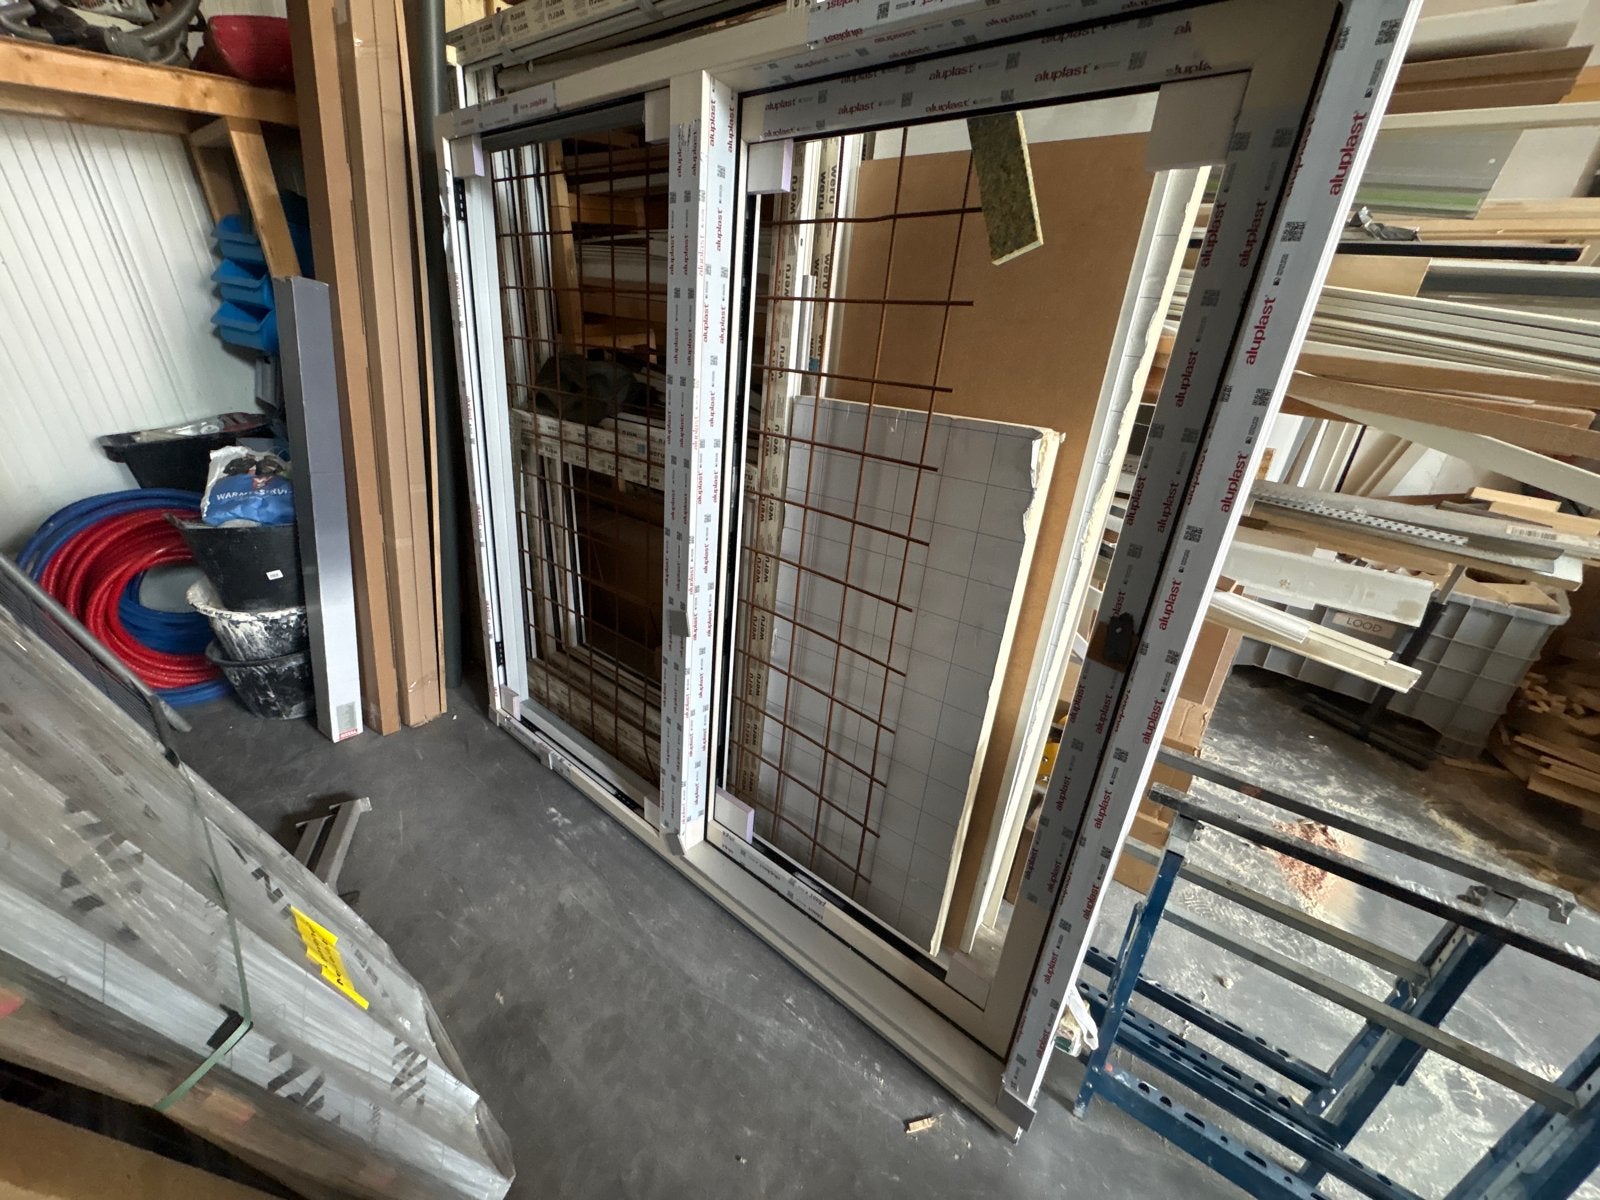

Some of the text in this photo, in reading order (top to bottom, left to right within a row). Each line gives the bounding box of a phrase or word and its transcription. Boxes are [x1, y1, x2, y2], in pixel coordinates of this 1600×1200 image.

[928, 64, 976, 81] aluplast
[1034, 63, 1091, 83] aluplast
[764, 97, 798, 111] aluplast
[838, 102, 875, 115] aluplast
[925, 99, 973, 113] aluplast
[727, 106, 735, 153] aluplast
[1329, 111, 1367, 196] aluplast
[789, 175, 798, 215] weru
[818, 171, 827, 210] weru
[828, 164, 838, 205] weru
[1201, 201, 1227, 268] aluplast
[1239, 200, 1267, 268] aluplast
[1246, 295, 1276, 365] aluplast
[1175, 350, 1198, 408] aluplast
[1126, 476, 1146, 526] aluplast
[1220, 452, 1249, 513] aluplast
[1157, 482, 1179, 534] aluplast
[1112, 590, 1126, 618] plast
[1159, 579, 1182, 630] aluplast
[1346, 617, 1382, 632] LOOD
[1070, 684, 1085, 723] aluplast
[1095, 694, 1113, 734] aluplast
[1142, 700, 1164, 745] aluplast
[1055, 776, 1071, 812] aluplast
[1094, 789, 1112, 829] aluplast
[1083, 884, 1099, 920] aluplast
